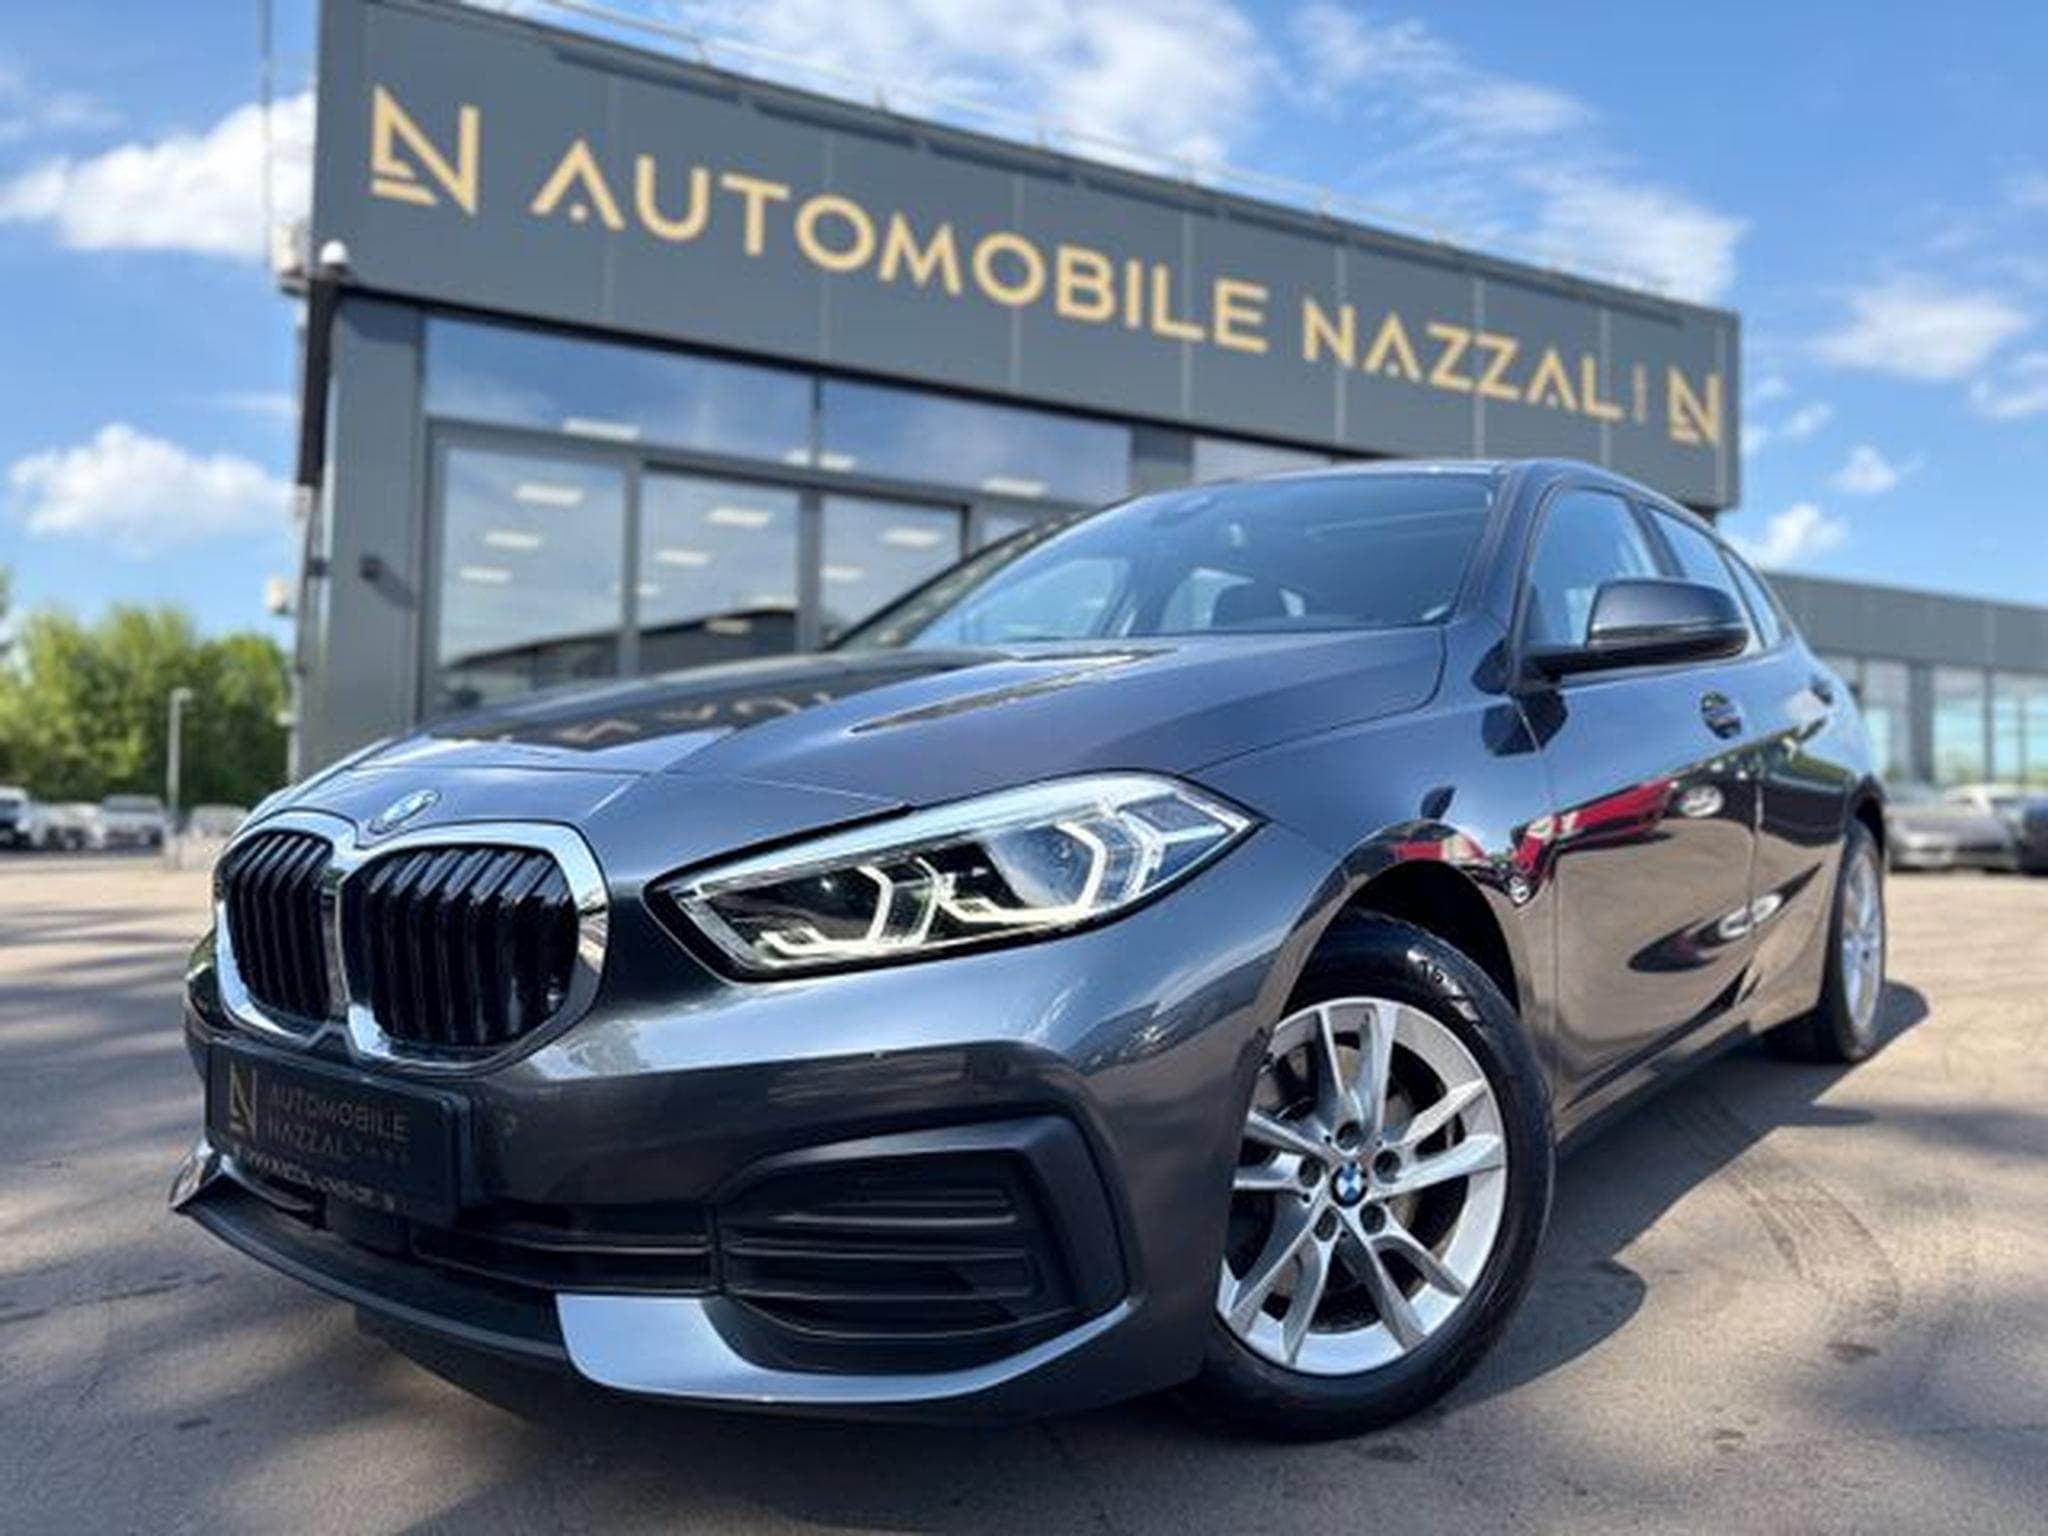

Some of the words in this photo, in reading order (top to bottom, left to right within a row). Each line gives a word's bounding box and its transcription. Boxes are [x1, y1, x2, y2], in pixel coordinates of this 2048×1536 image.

[531, 138, 1269, 353] AUTOMOBILE
[1303, 297, 1625, 419] NAZZAL
[268, 1080, 410, 1144] AUTOMOBILE
